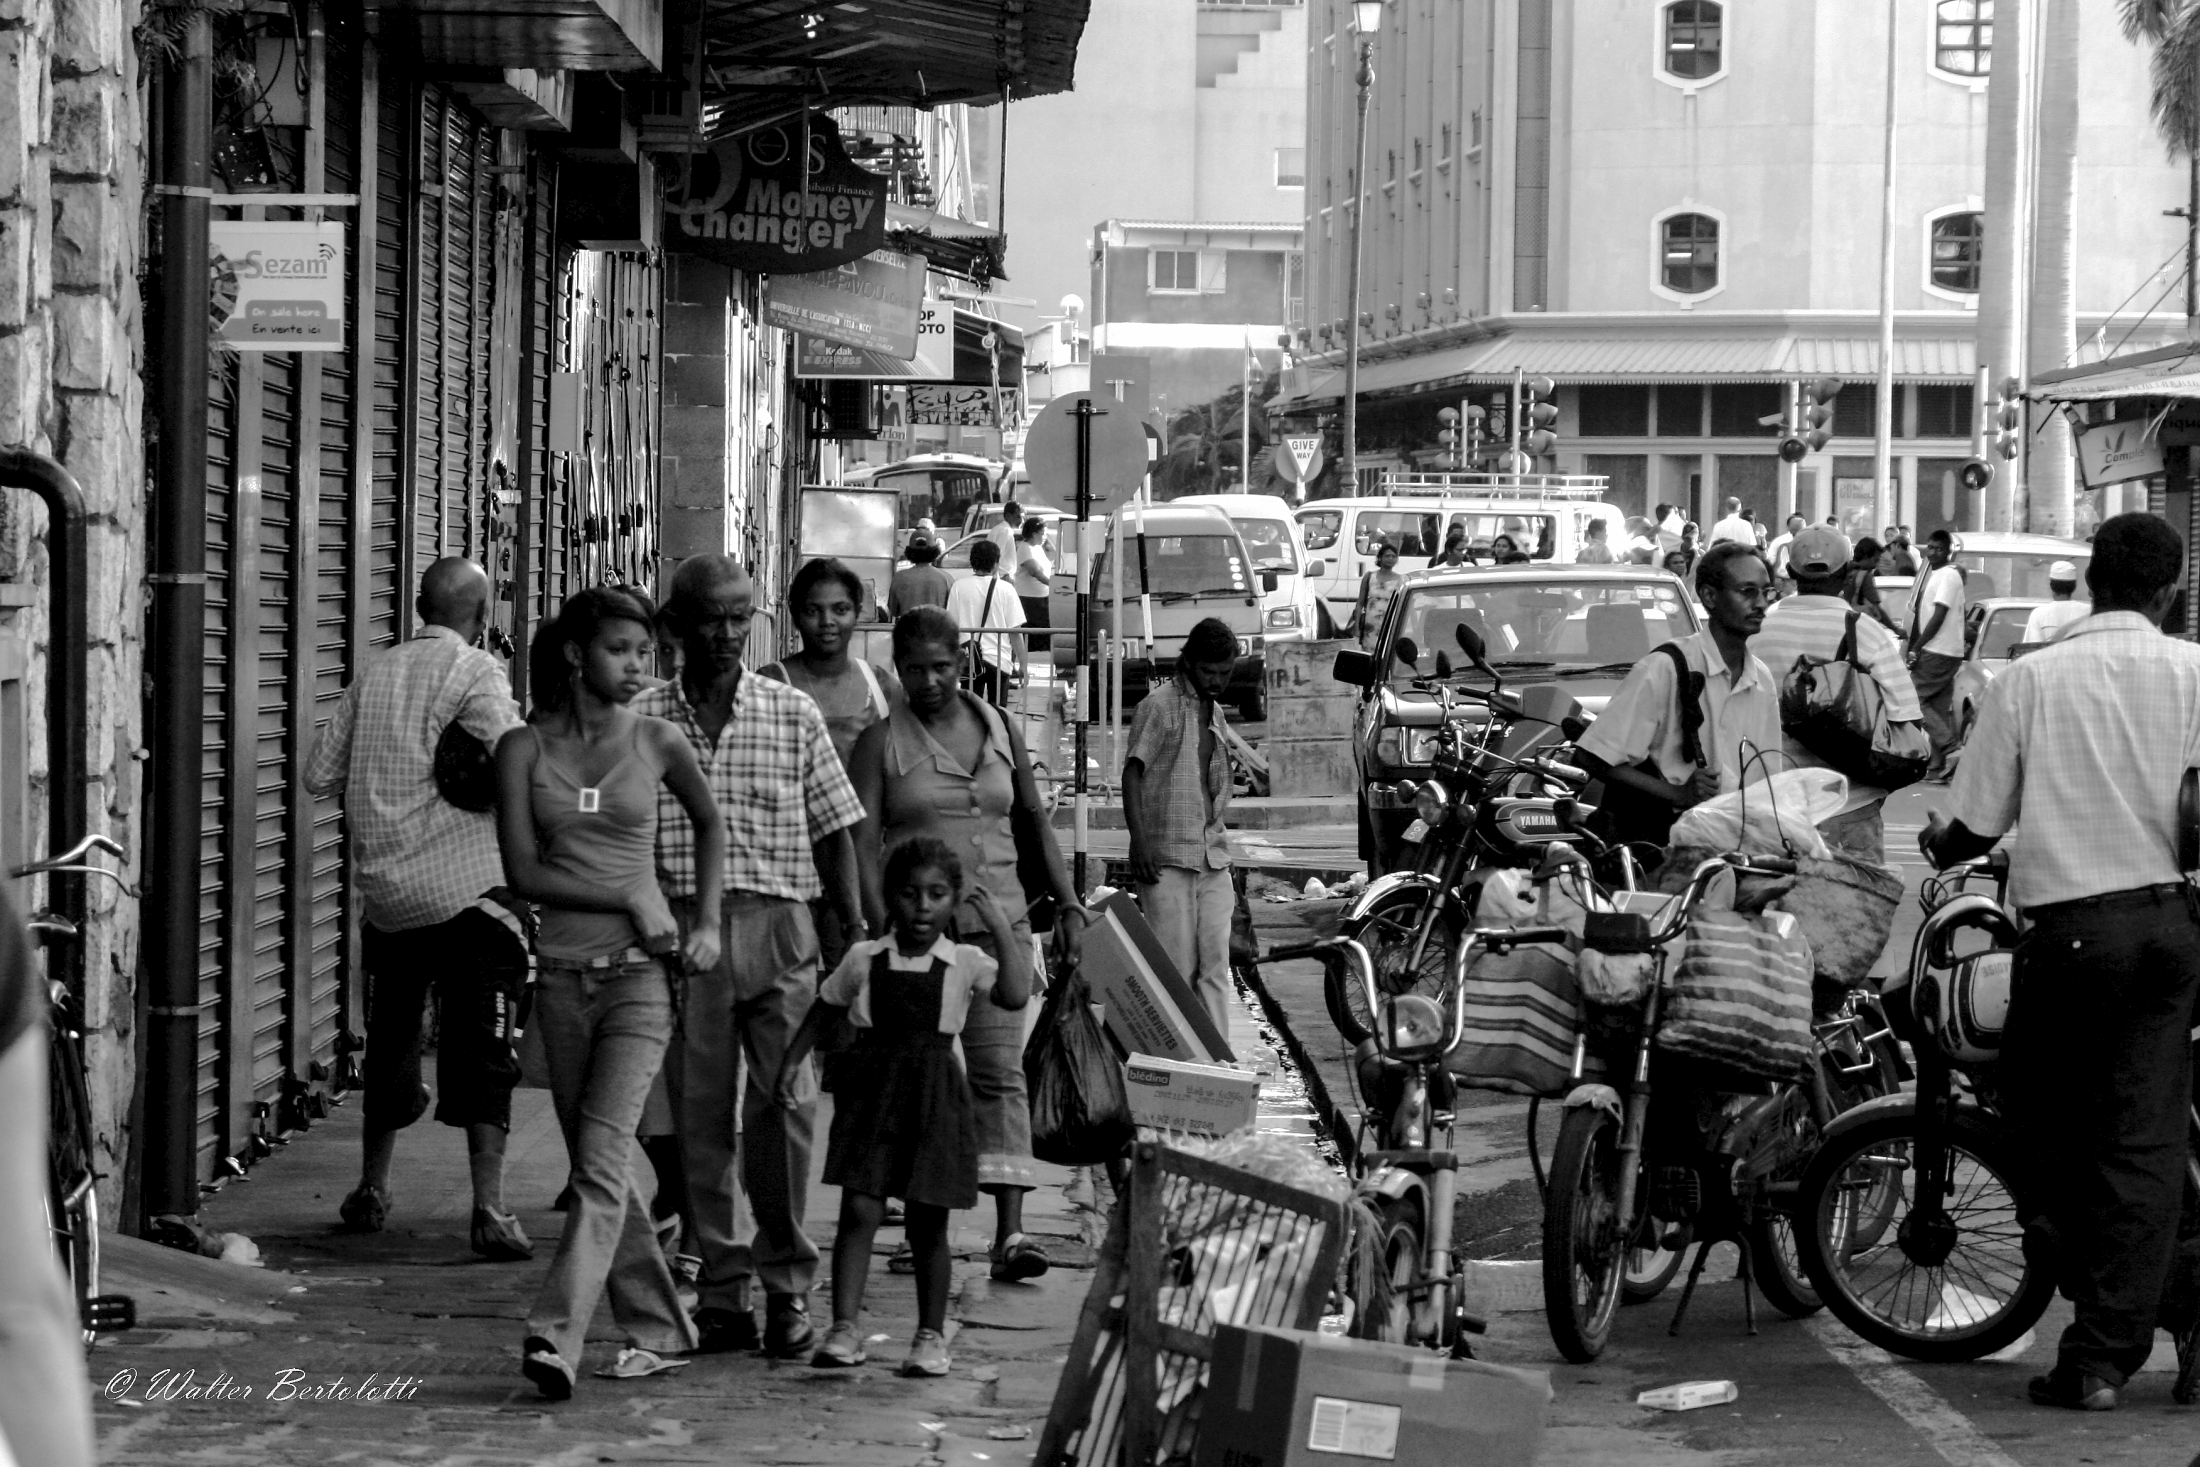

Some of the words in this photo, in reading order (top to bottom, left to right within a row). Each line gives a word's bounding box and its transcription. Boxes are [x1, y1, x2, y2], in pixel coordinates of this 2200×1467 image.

[838, 184, 874, 196] Finance
[745, 178, 875, 230] Money
[680, 197, 852, 254] Changer
[245, 249, 328, 279] Sezam
[252, 307, 266, 317] On
[269, 306, 292, 317] sale
[296, 306, 321, 317] here
[252, 323, 267, 334] En
[271, 324, 303, 334] vente
[308, 324, 321, 334] ici
[825, 346, 853, 356] Kodak
[1291, 440, 1314, 450] GIVE
[1519, 815, 1557, 826] YAMAHA
[1125, 975, 1151, 1008] SMOOTH
[1144, 1005, 1178, 1051] SERVIETTES
